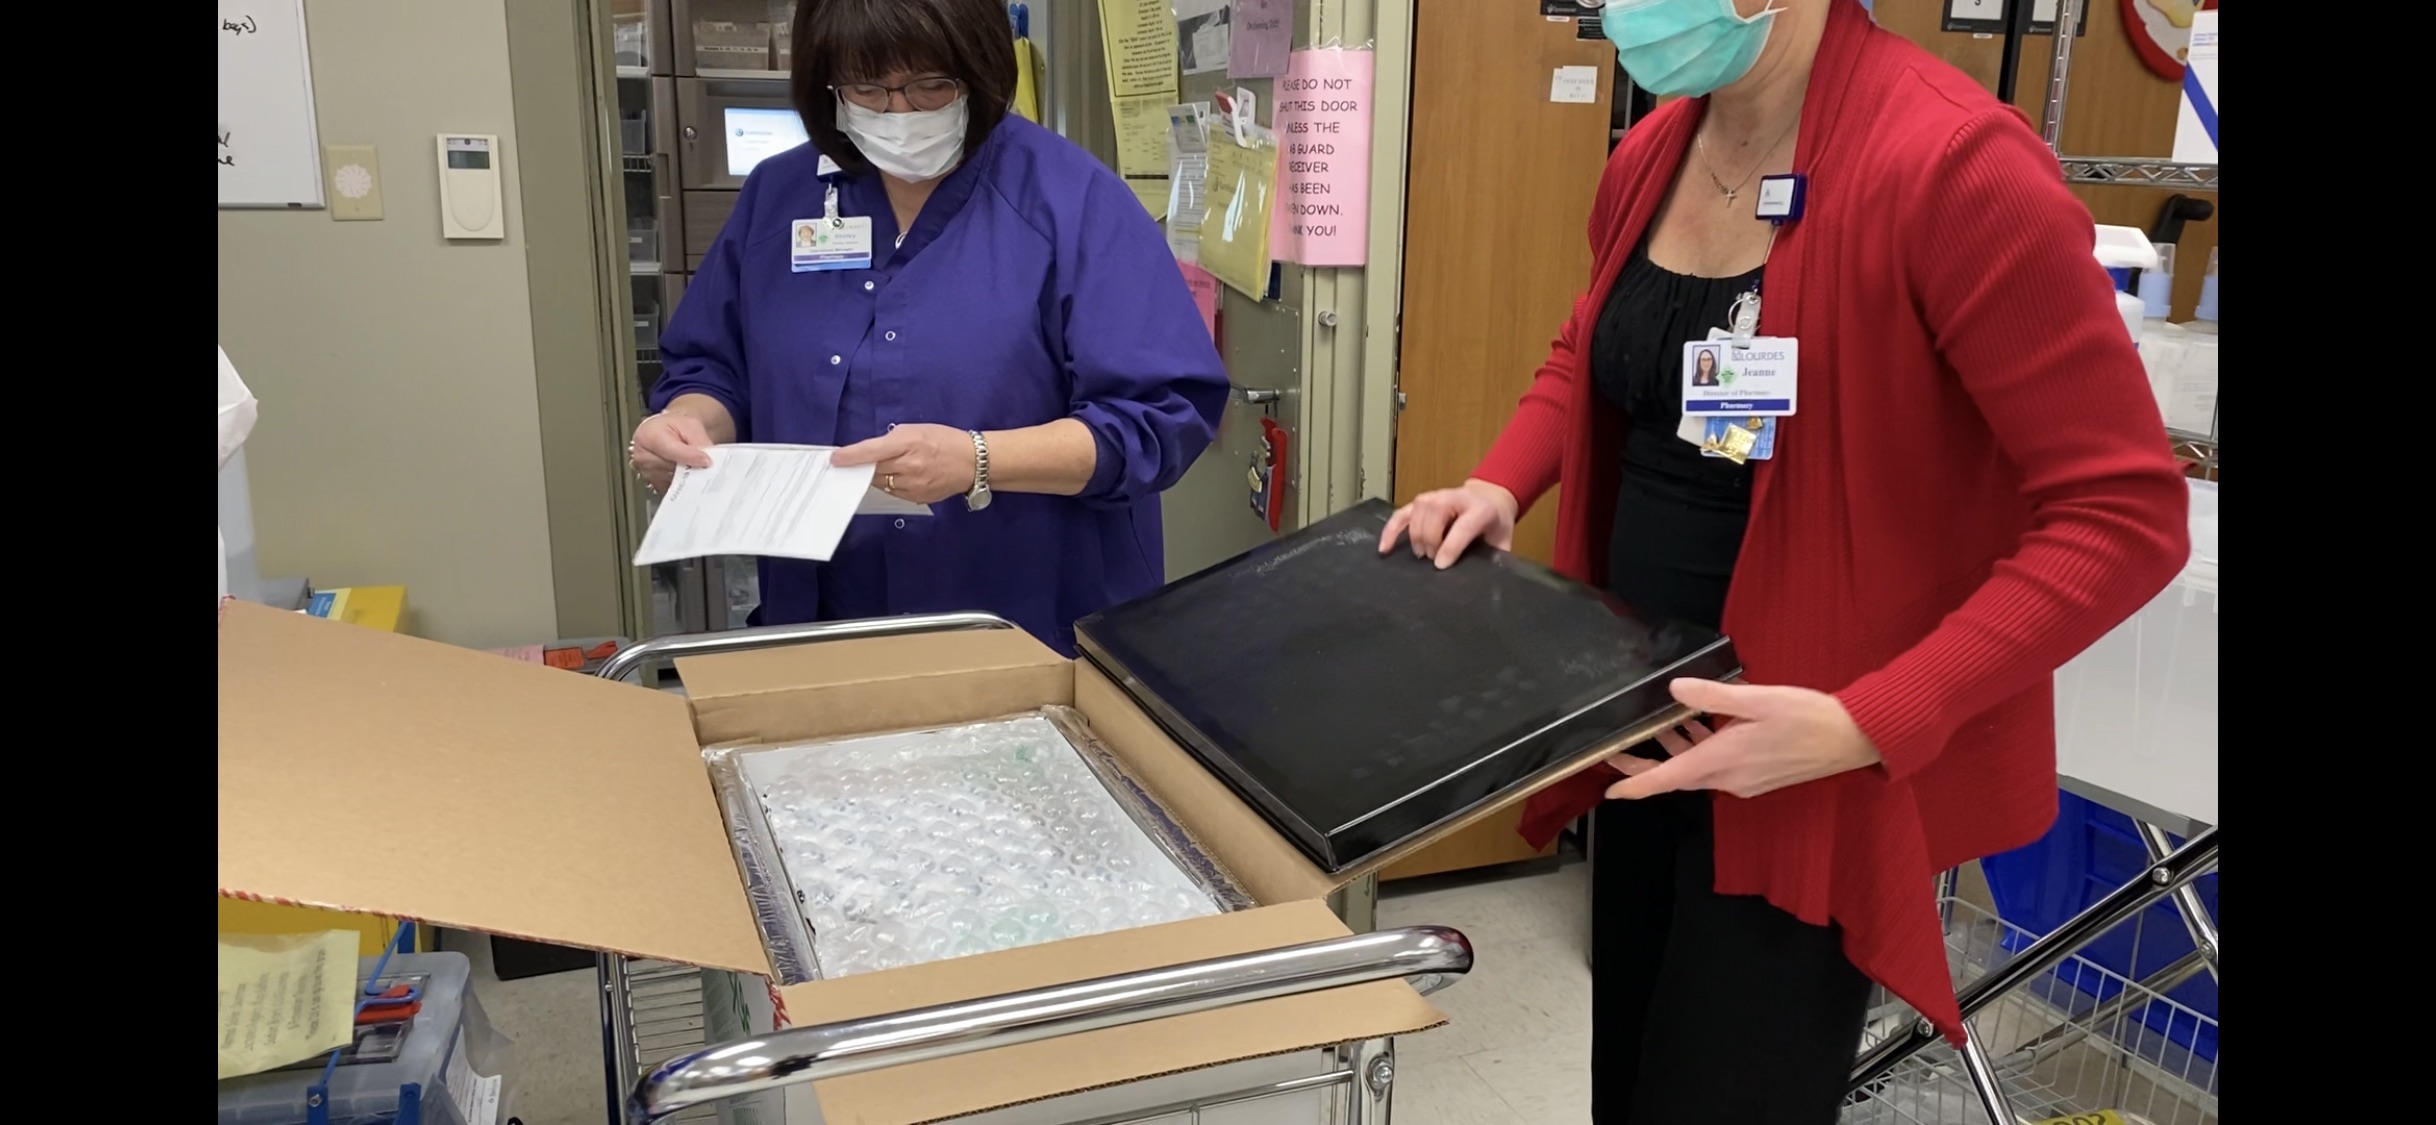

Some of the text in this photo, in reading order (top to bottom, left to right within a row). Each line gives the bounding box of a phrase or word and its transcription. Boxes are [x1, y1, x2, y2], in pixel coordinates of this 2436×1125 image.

[1301, 78, 1318, 90] DO
[1323, 78, 1352, 90] NOT
[1294, 99, 1316, 112] THIS
[1321, 99, 1358, 112] DOOR
[1313, 121, 1340, 133] THE
[1300, 182, 1331, 194] BEEN
[1300, 203, 1344, 216] DOWN.
[1305, 224, 1337, 237] YOU!
[1740, 352, 1785, 361] LOURDES
[1742, 368, 1776, 376] Jeanne
